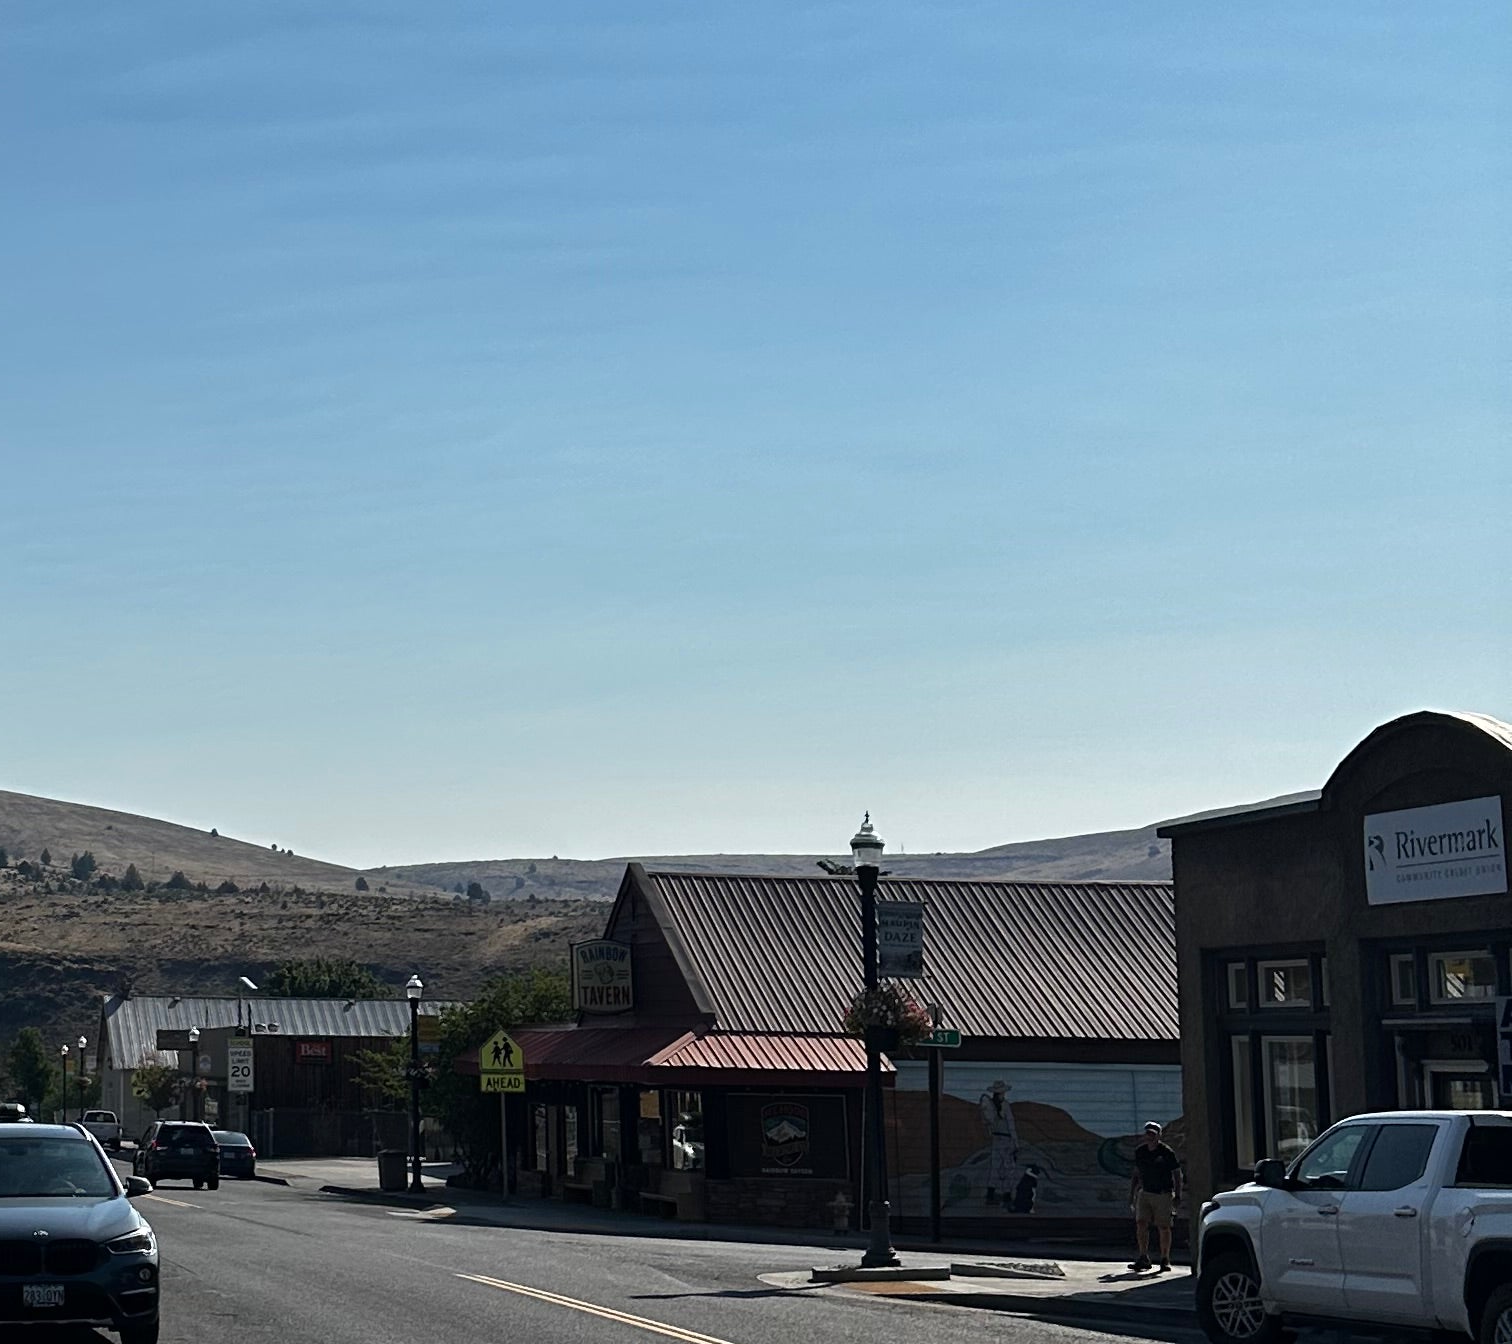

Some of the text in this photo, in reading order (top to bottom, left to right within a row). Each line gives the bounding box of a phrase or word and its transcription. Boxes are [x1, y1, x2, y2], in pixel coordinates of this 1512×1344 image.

[1395, 819, 1498, 860] Rivermark
[884, 932, 917, 943] DAZE
[580, 945, 628, 963] RAINBOW
[582, 986, 630, 1005] TAVERN
[936, 1032, 951, 1044] ST
[300, 1043, 328, 1057] Best
[231, 1066, 251, 1077] 20
[486, 1077, 521, 1089] AHEAD
